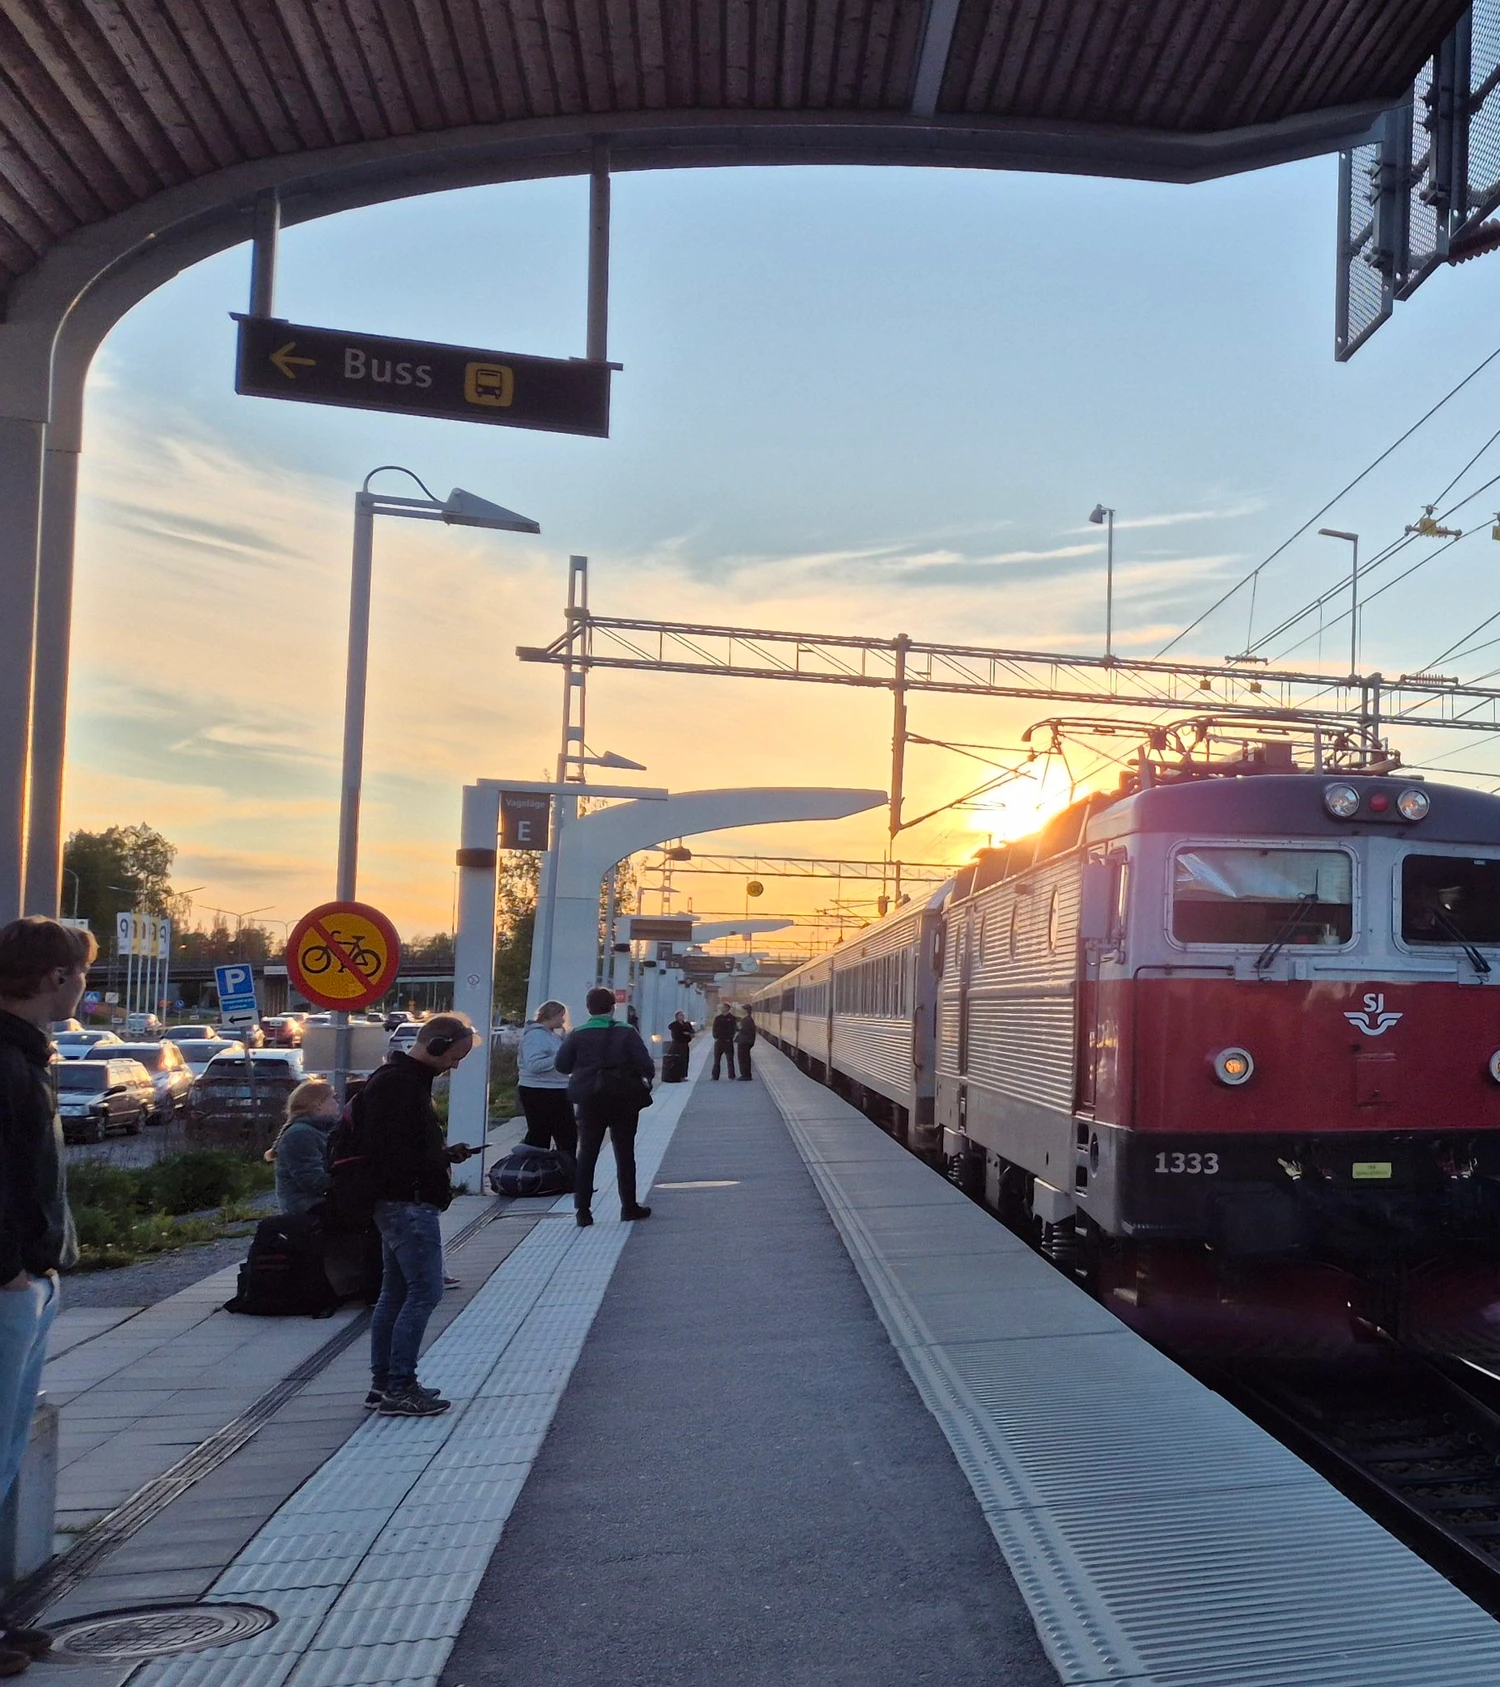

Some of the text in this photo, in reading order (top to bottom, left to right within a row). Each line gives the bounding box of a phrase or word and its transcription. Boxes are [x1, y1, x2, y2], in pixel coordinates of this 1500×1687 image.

[344, 348, 432, 388] Buss
[505, 798, 545, 809] Vagnläge
[517, 820, 531, 842] E
[225, 968, 246, 994] P
[1363, 993, 1384, 1013] SJ
[1154, 1152, 1219, 1174] 1333
